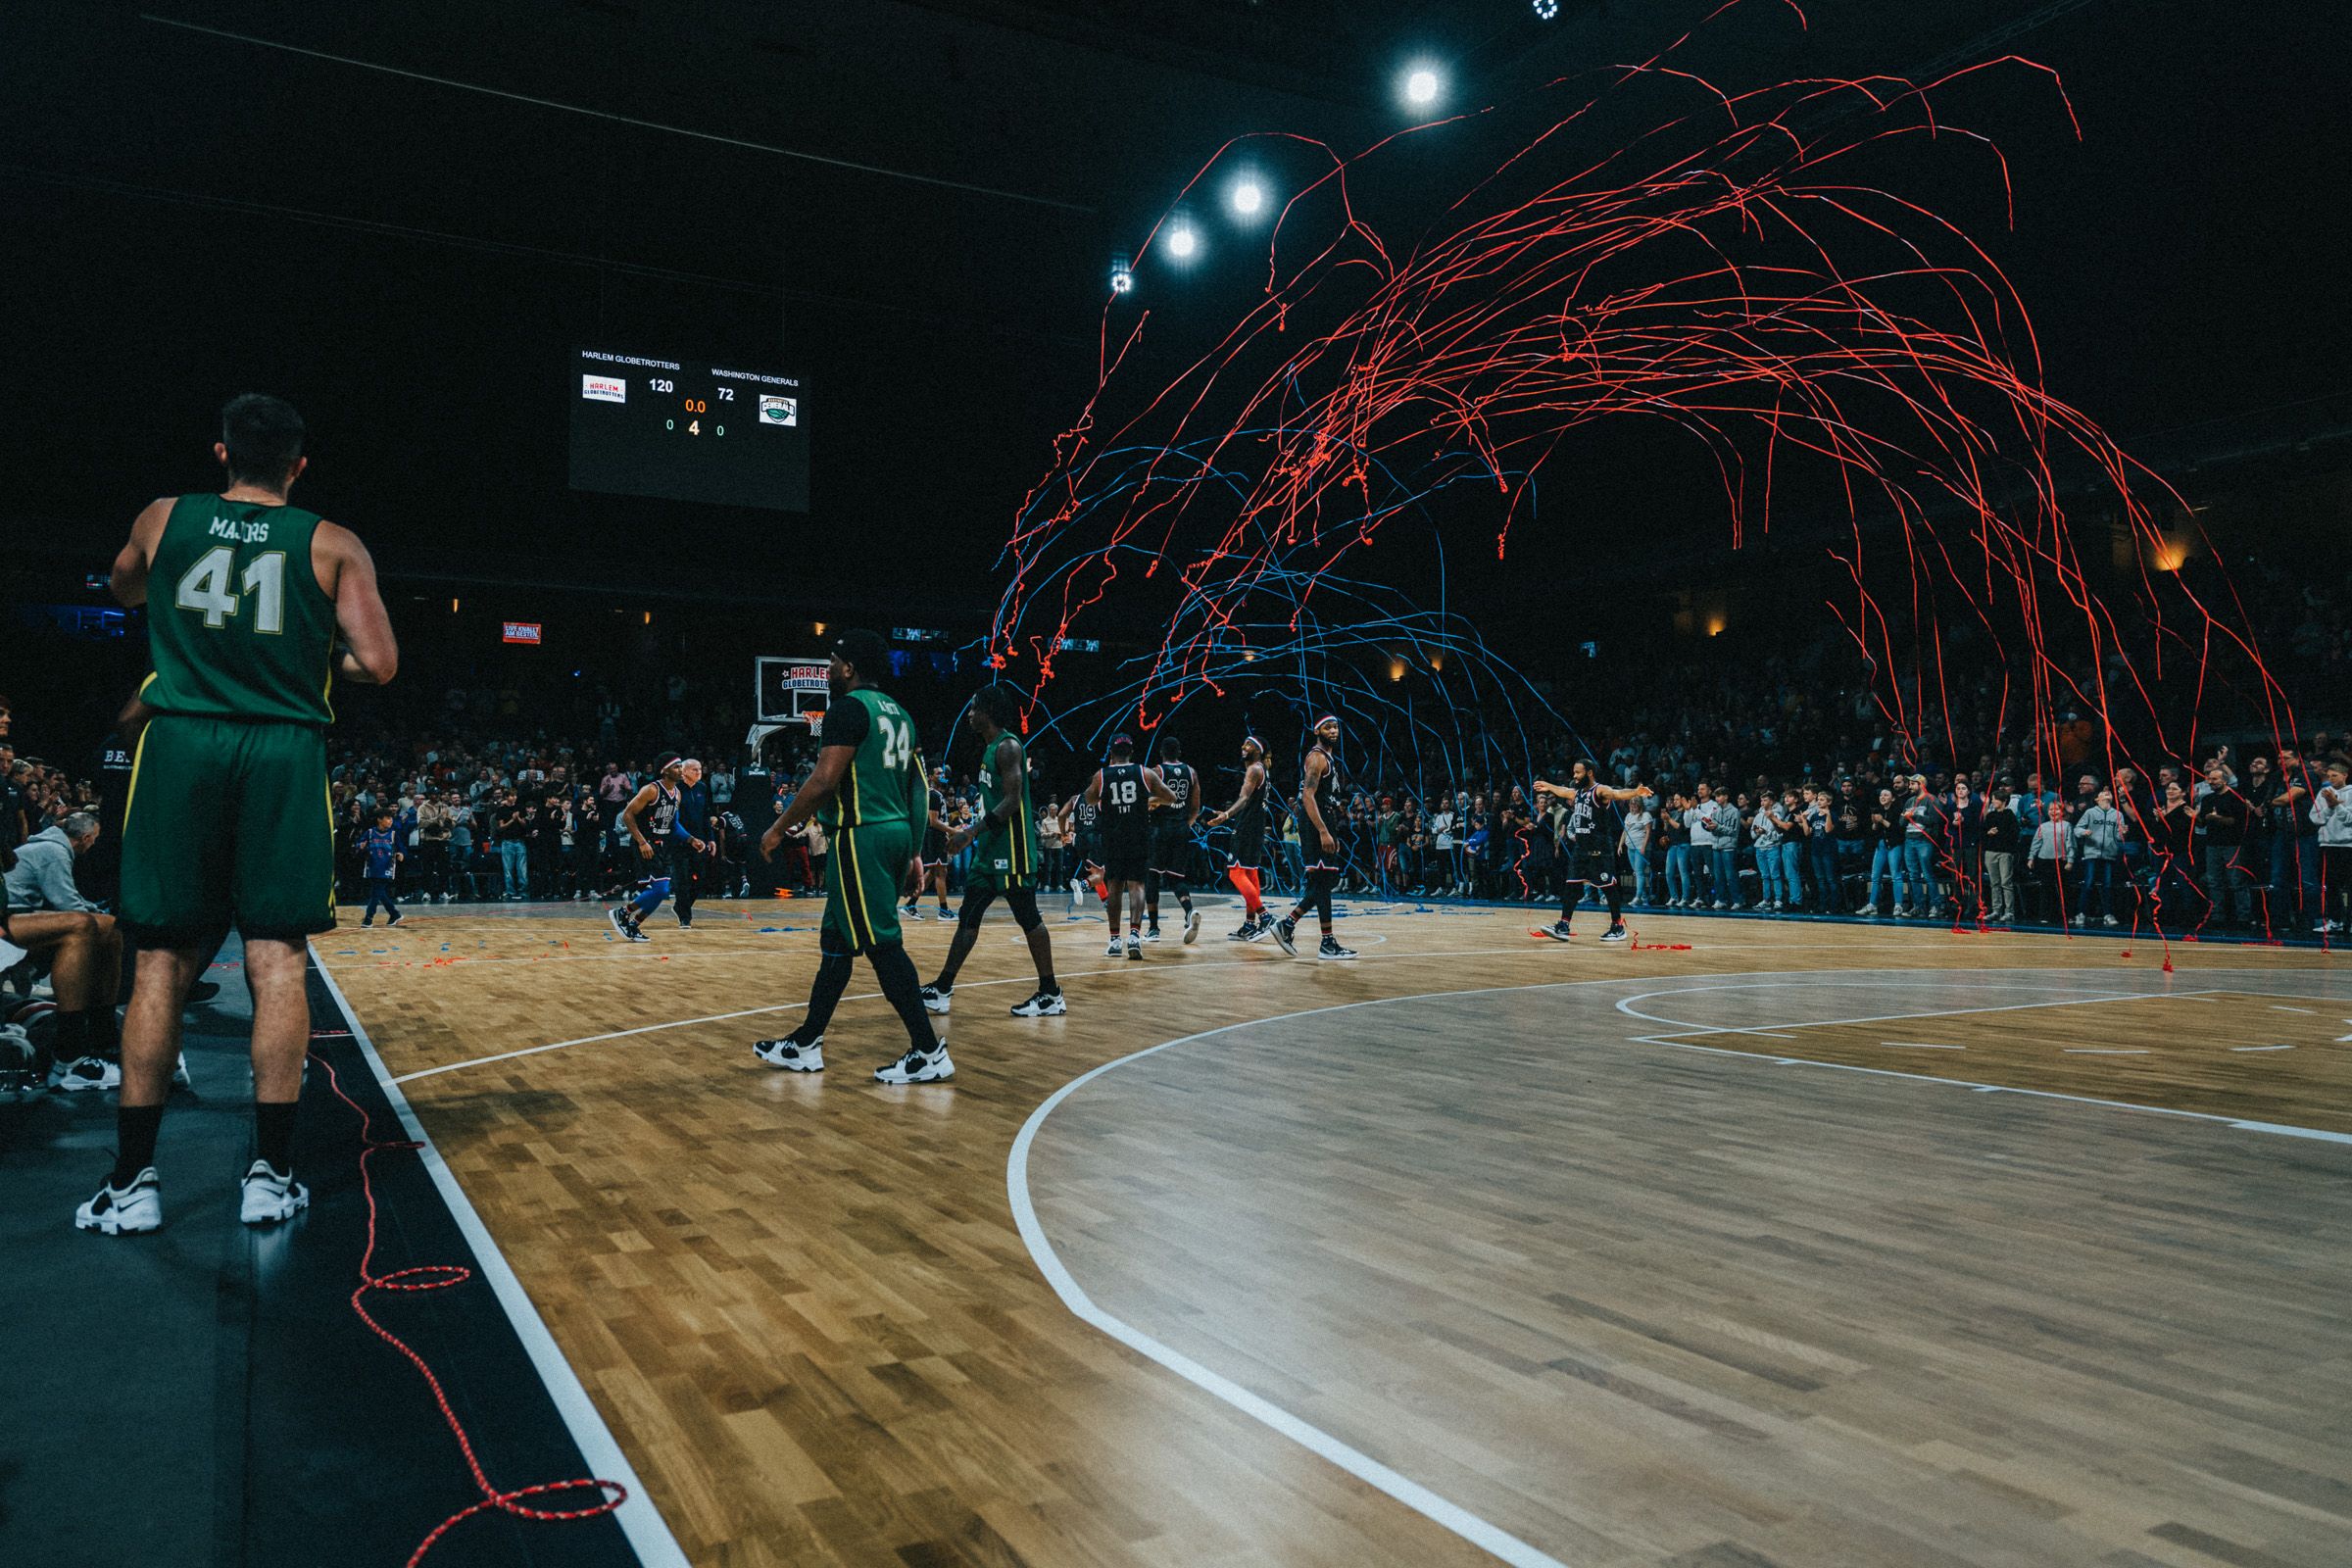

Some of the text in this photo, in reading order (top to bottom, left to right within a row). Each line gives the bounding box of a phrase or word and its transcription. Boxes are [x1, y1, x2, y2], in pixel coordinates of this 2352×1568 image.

[582, 351, 680, 370] HARLEM GLOBETROTTERS
[711, 368, 799, 387] WASHINGTON GENERALS
[589, 382, 618, 392] HARLEM
[649, 378, 673, 393] 120
[584, 390, 624, 399] GLOBETROTTERS
[717, 387, 734, 401] 72
[686, 399, 706, 414] 0.0
[666, 419, 674, 430] 0
[688, 419, 700, 435] 4
[716, 425, 724, 436] 0
[175, 546, 287, 635] 41
[783, 678, 830, 689] GLOBETROTT
[877, 715, 911, 771] 24
[1109, 781, 1137, 805] 18
[1079, 804, 1096, 820] 19
